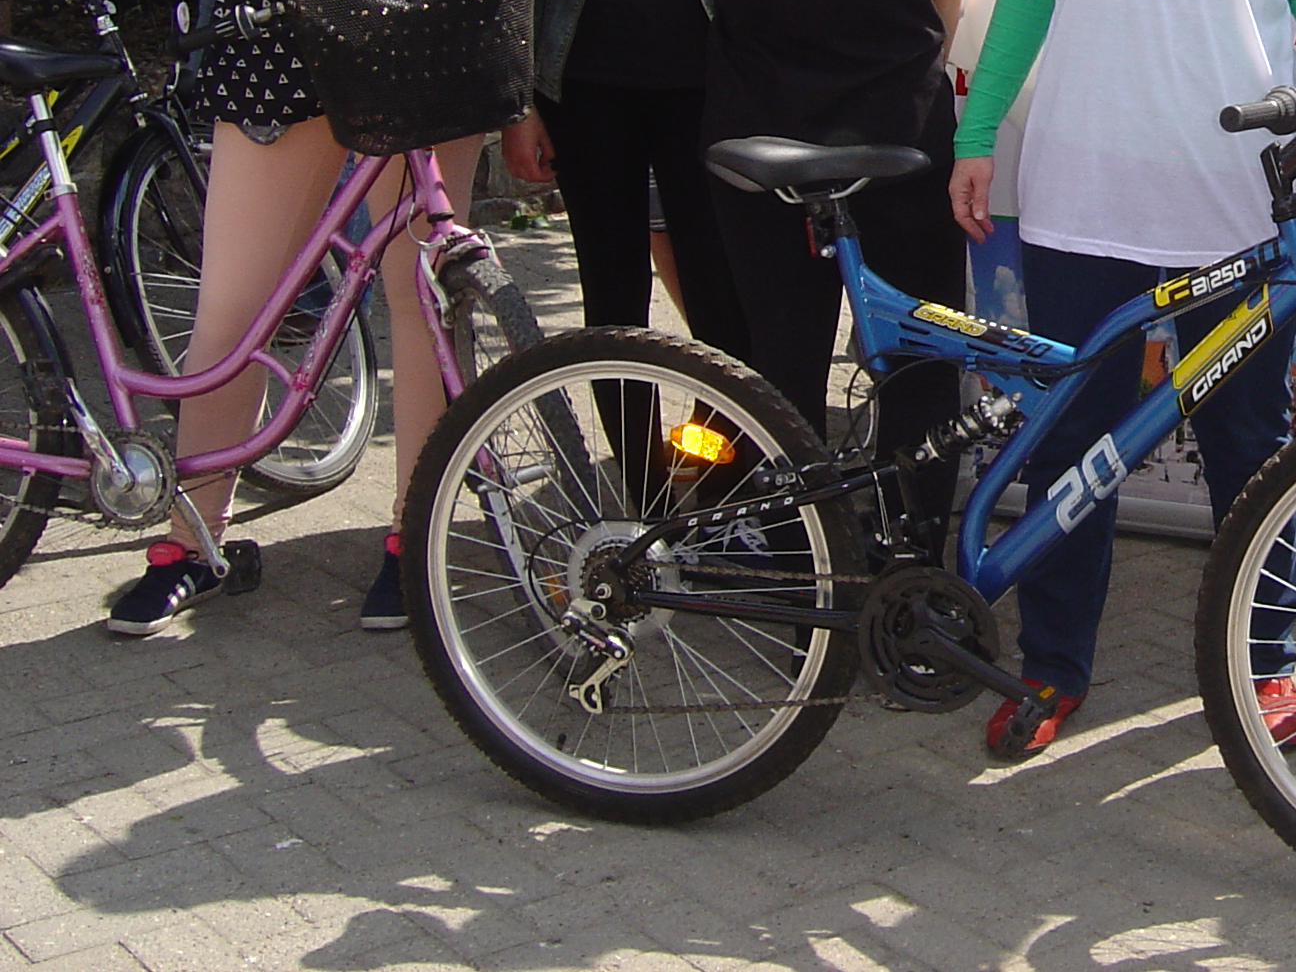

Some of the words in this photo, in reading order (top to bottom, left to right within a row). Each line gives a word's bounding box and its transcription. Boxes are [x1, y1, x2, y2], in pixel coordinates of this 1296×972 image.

[914, 309, 988, 337] GRAND
[1192, 317, 1267, 402] GRAND
[687, 496, 794, 527] GRAND
[1046, 432, 1127, 535] 20
